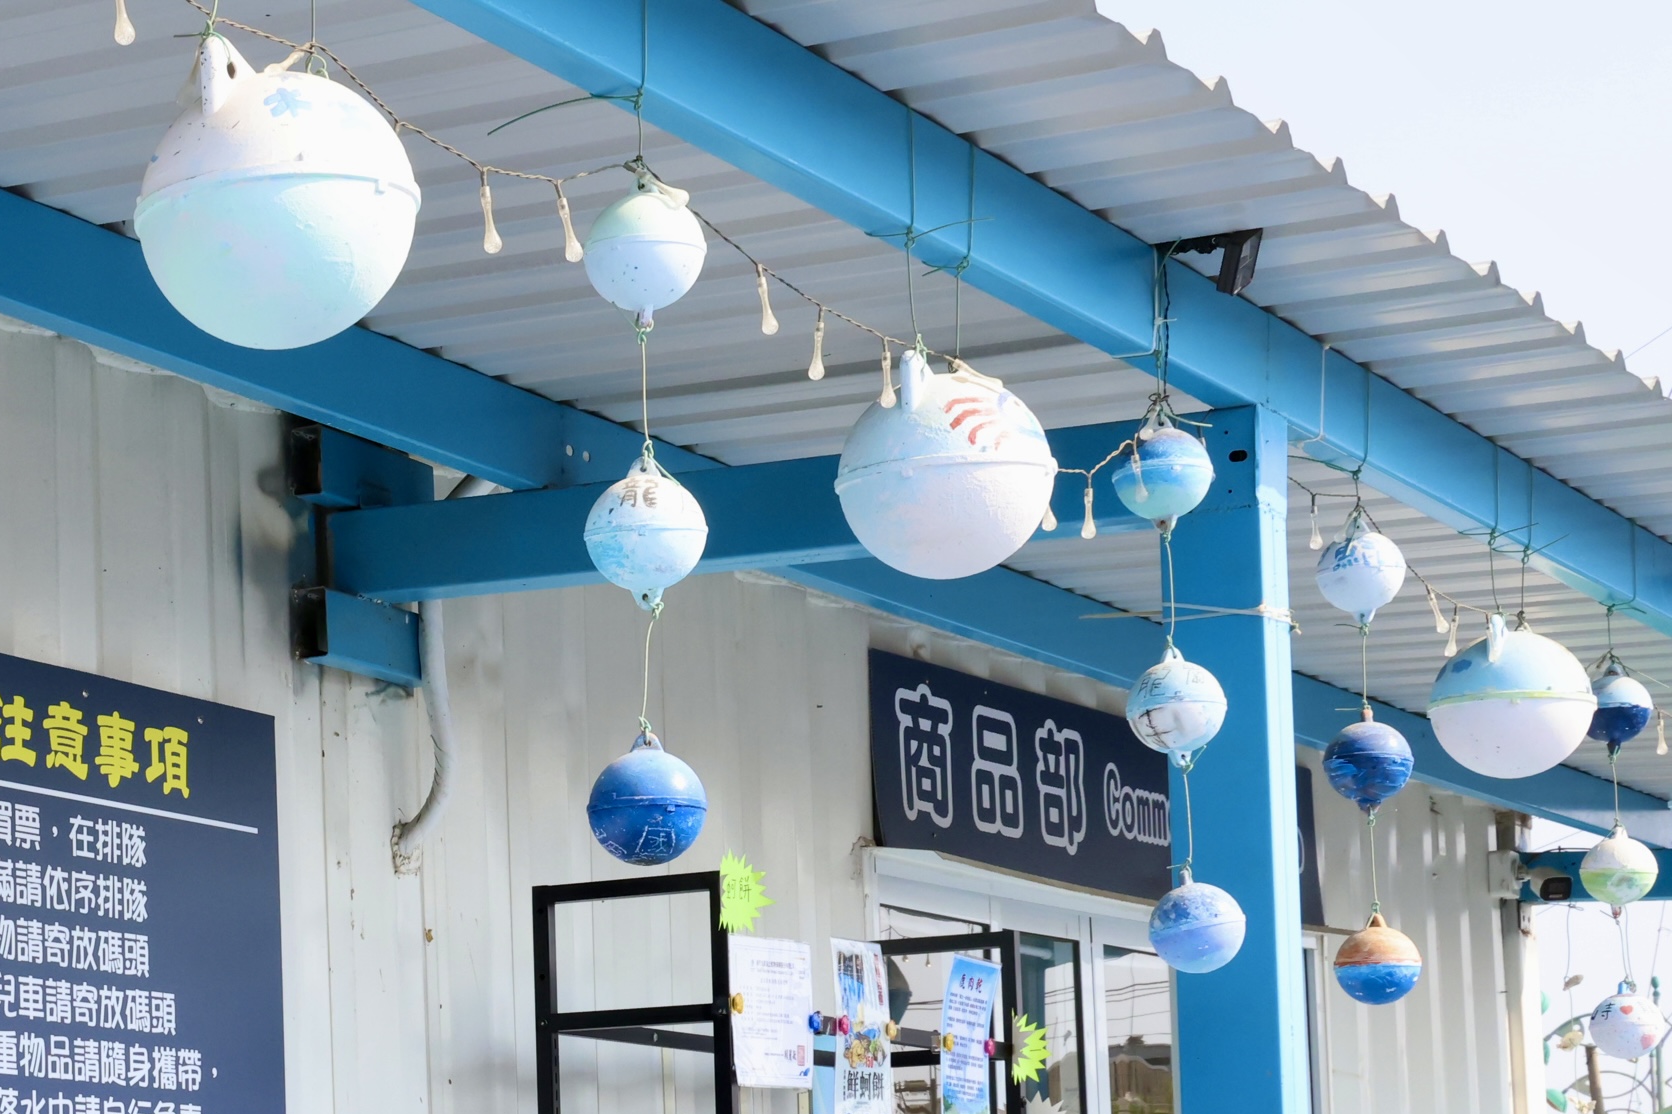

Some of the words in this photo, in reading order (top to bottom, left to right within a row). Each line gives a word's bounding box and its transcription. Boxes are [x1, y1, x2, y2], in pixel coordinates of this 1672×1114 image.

[895, 682, 1087, 856] 商品部
[1103, 762, 1171, 847] Comm
